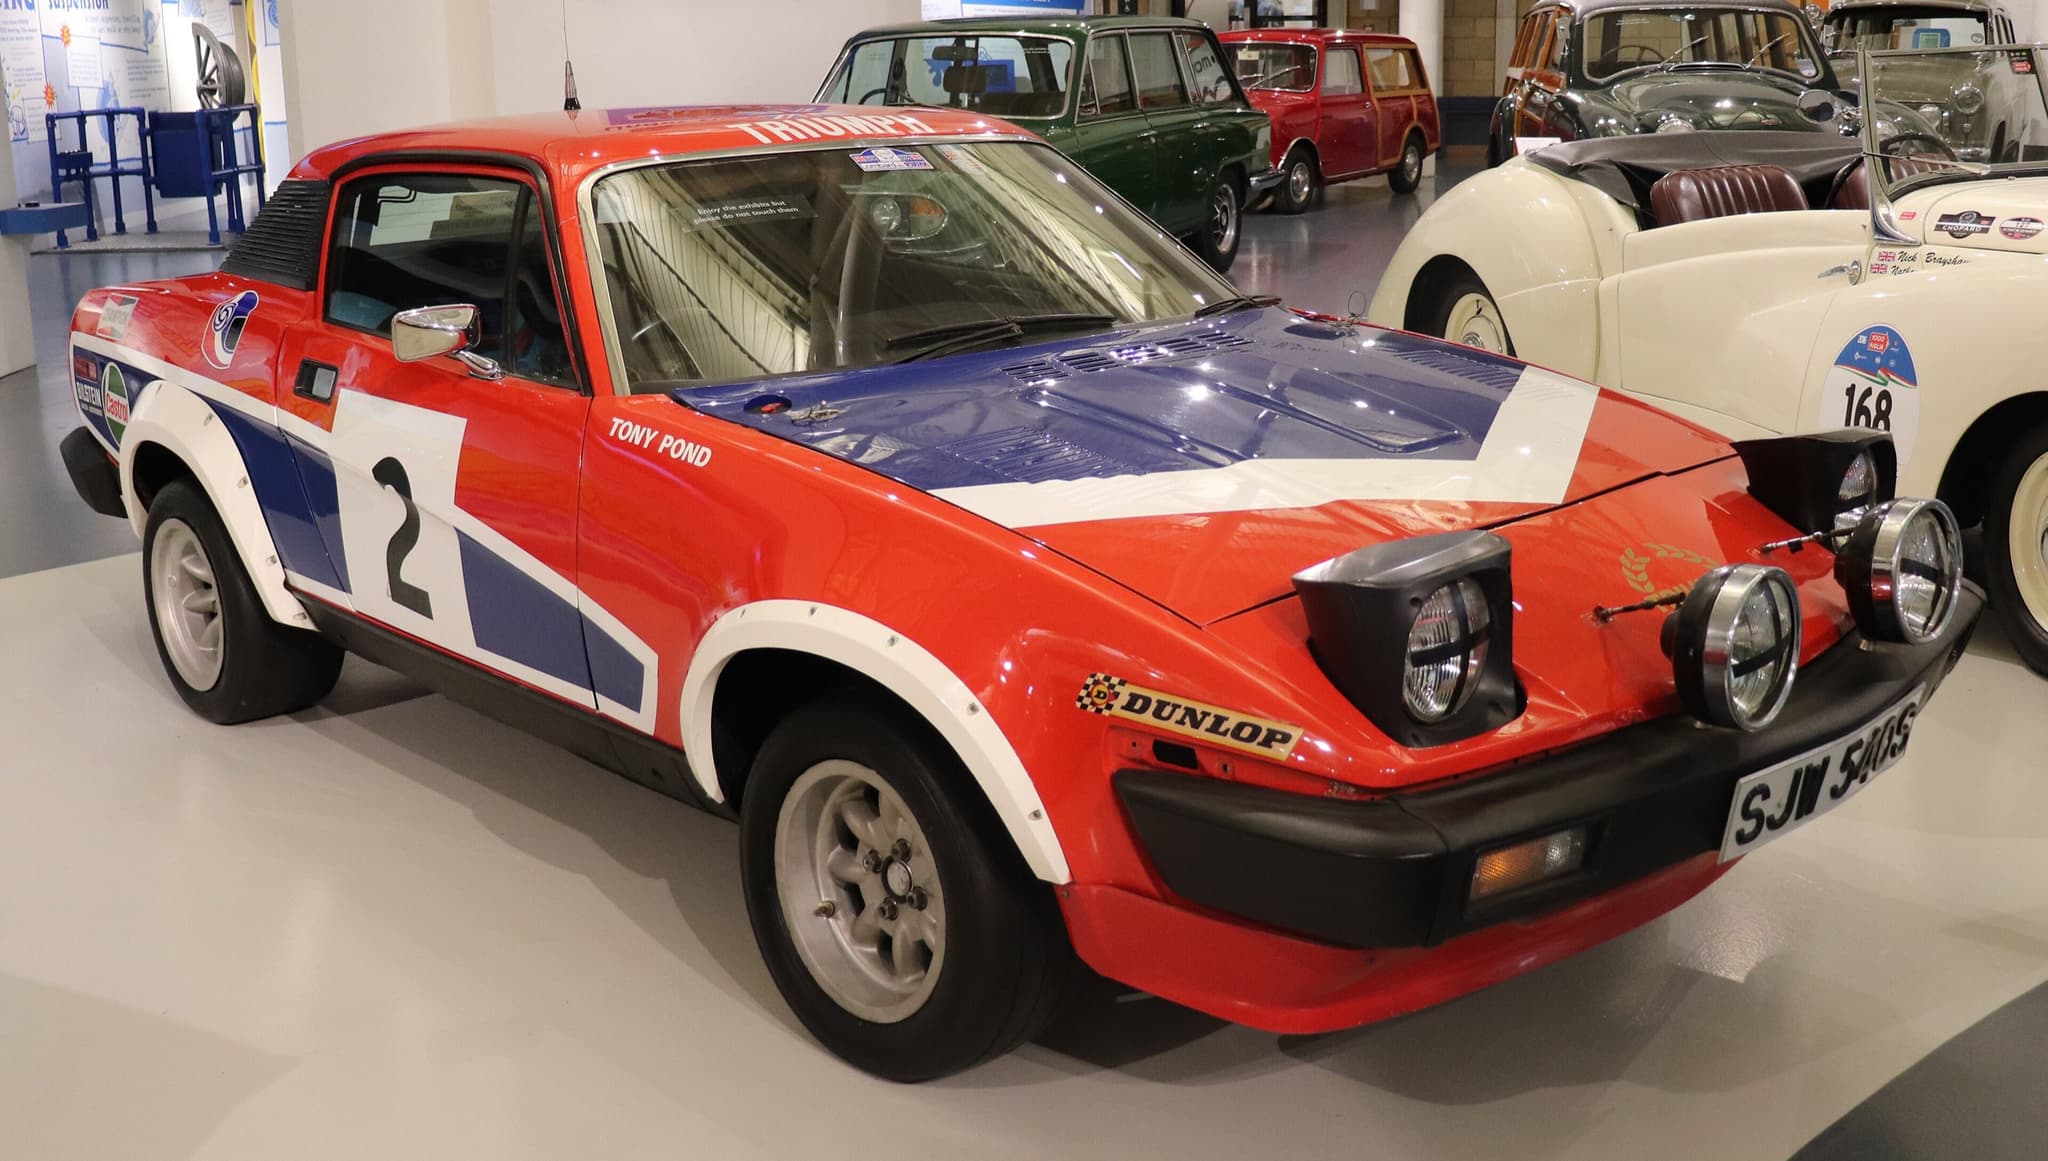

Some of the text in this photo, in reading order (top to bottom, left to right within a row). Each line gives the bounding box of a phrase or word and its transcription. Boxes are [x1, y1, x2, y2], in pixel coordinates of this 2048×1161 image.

[725, 115, 937, 144] TRIUMPH
[694, 216, 720, 224] please
[697, 207, 720, 216] Enjoy
[1942, 224, 1982, 233] CHOPARD
[1898, 251, 1918, 263] Nick
[106, 391, 128, 423] Castrol
[1844, 383, 1892, 432] 168
[609, 416, 712, 468] TONY POND
[371, 456, 434, 620] 2
[1120, 691, 1293, 749] DUNLOP
[1735, 755, 1831, 846] SJW
